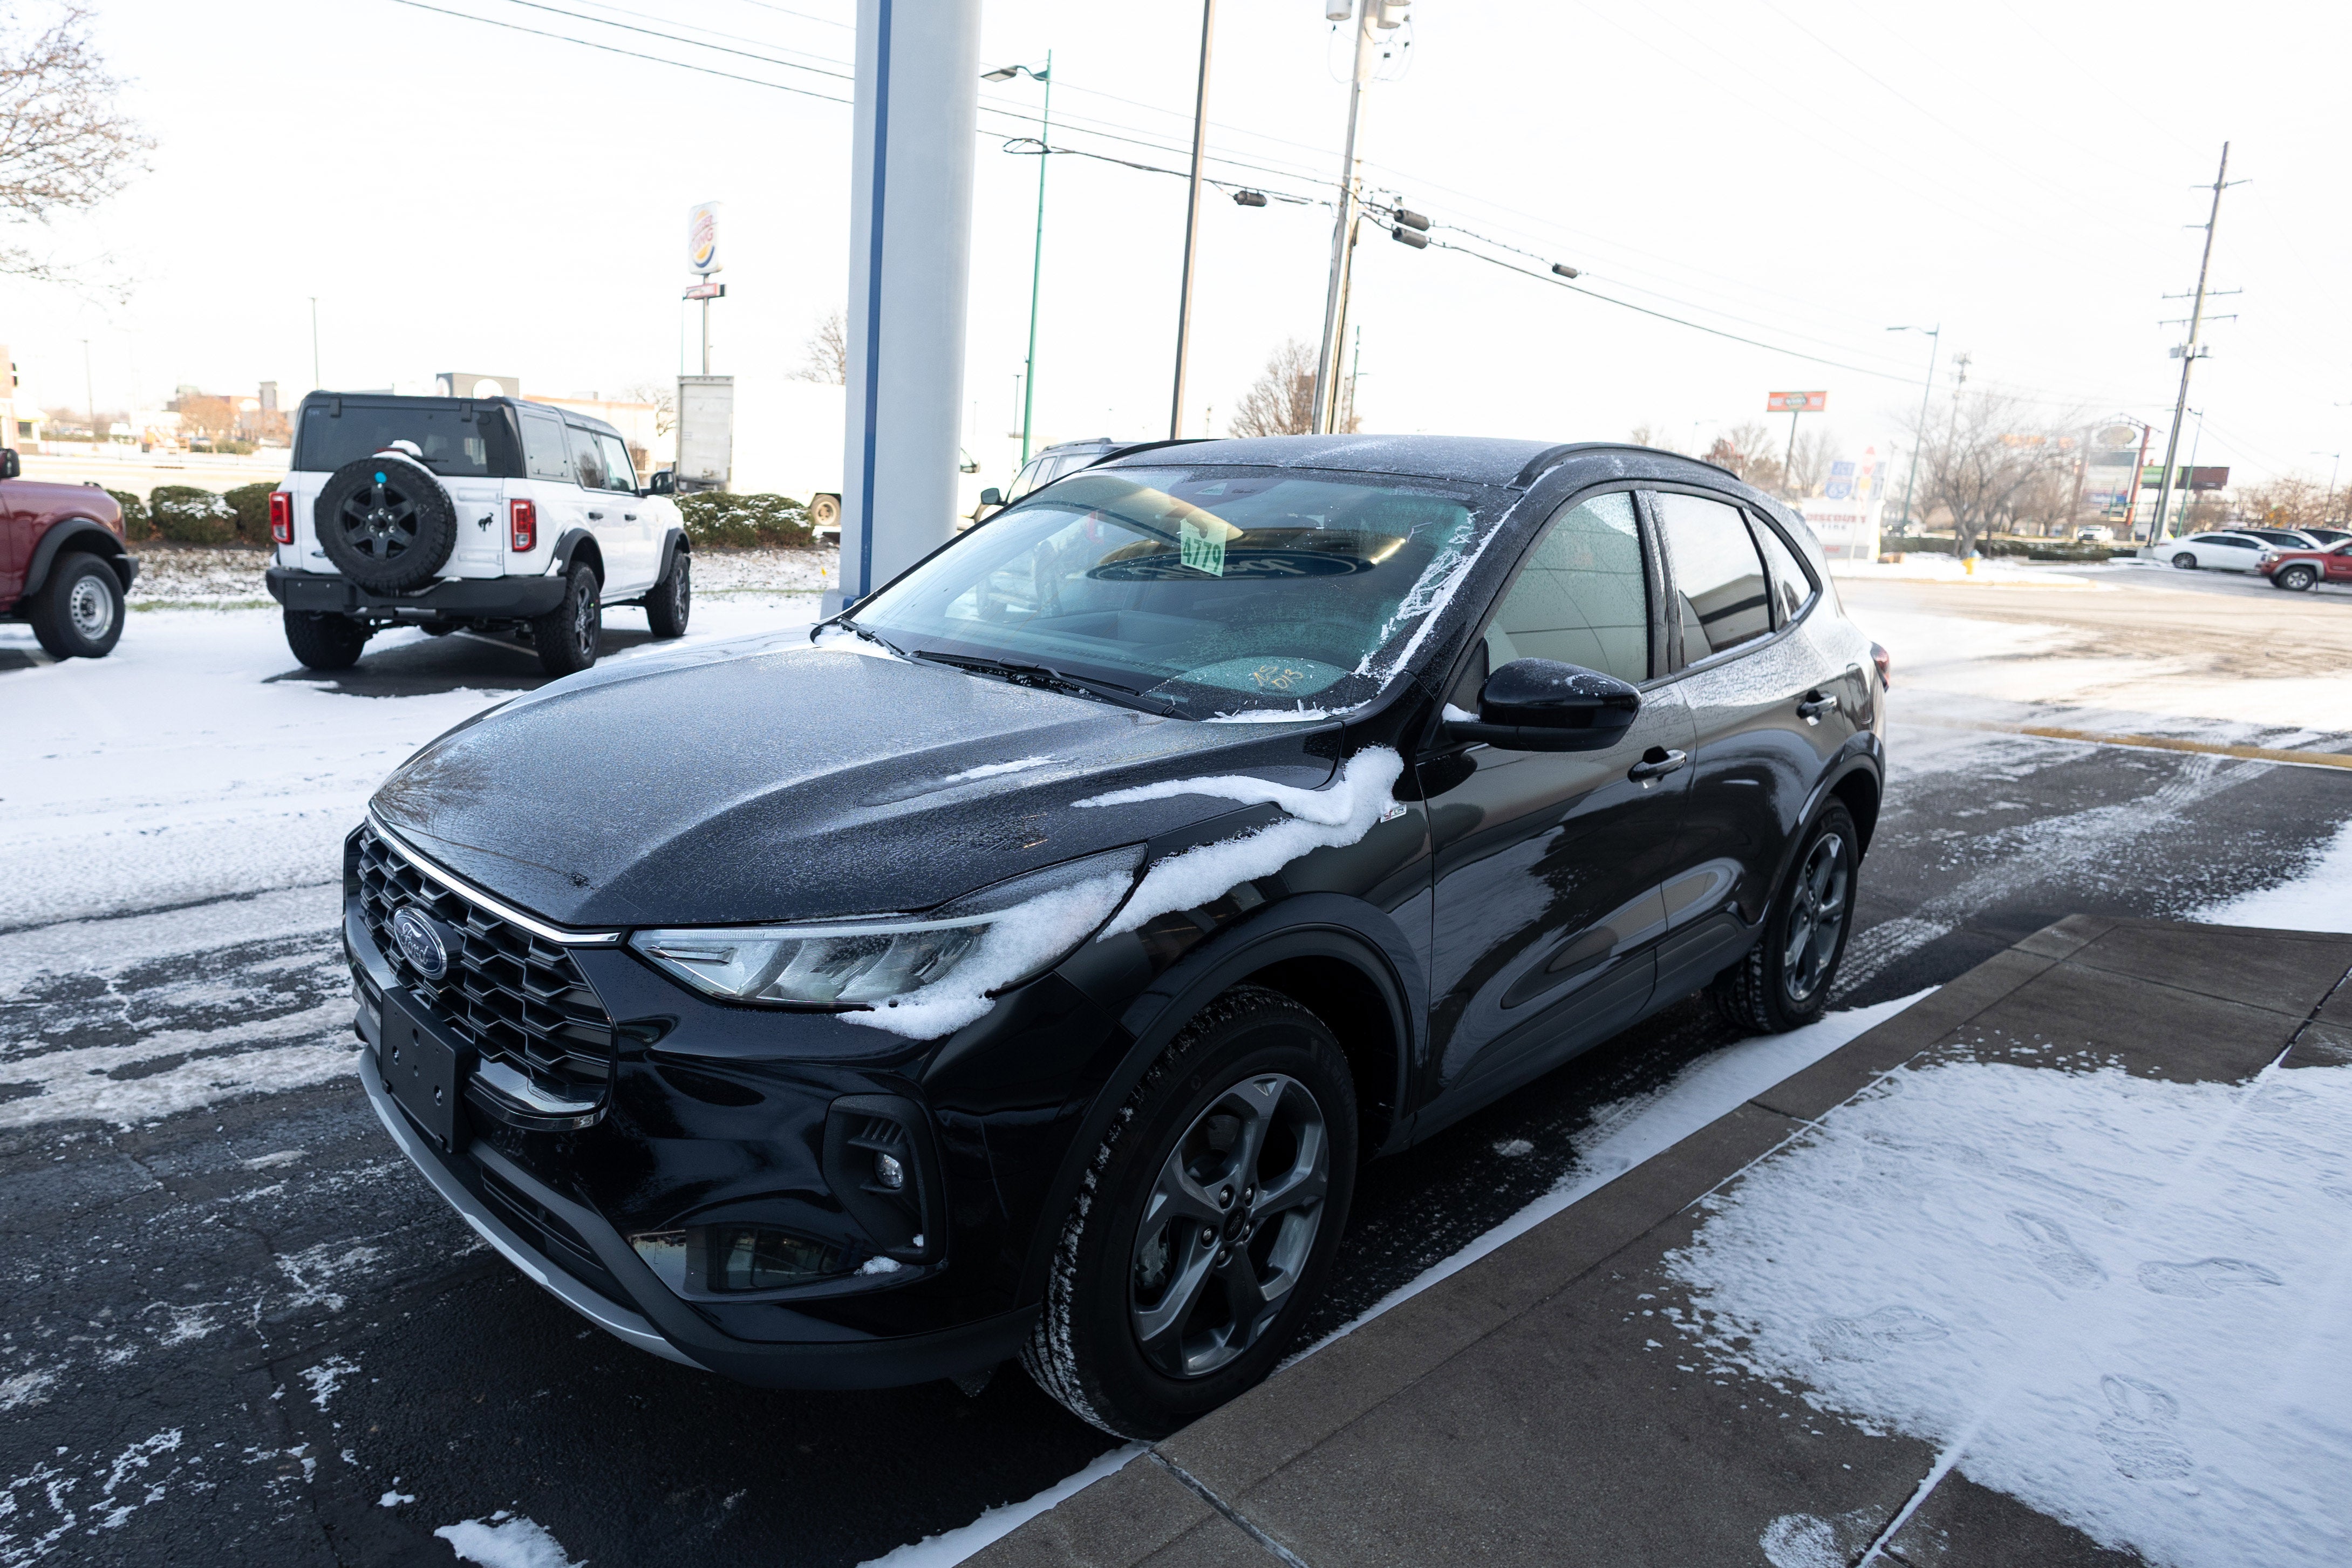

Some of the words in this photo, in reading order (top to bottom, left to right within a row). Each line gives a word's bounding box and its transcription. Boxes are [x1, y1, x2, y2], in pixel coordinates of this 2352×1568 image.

[1829, 483, 1847, 496] 65
[1182, 536, 1222, 572] 4779
[400, 922, 429, 964] Ford
